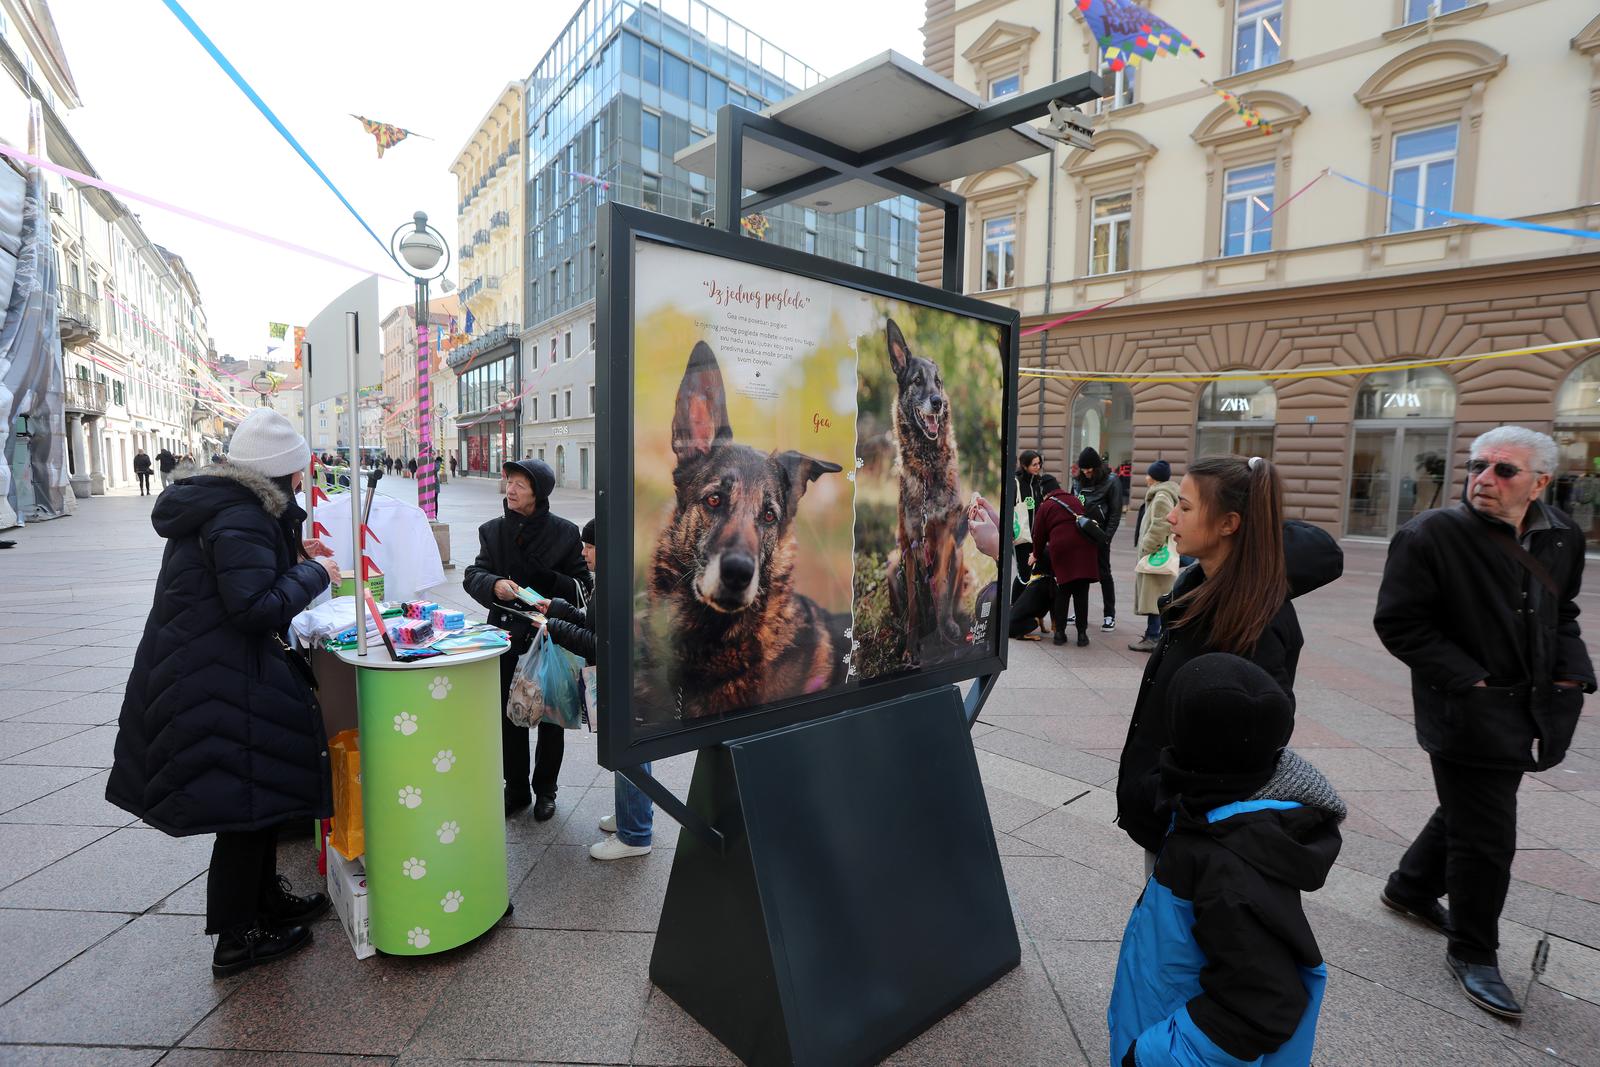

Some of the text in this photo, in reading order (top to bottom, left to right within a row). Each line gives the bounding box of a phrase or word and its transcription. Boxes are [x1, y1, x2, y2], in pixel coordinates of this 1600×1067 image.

[725, 284, 760, 309] jednog
[727, 312, 737, 320] Gea
[1220, 398, 1250, 412] ZARA
[812, 412, 831, 433] Gea
